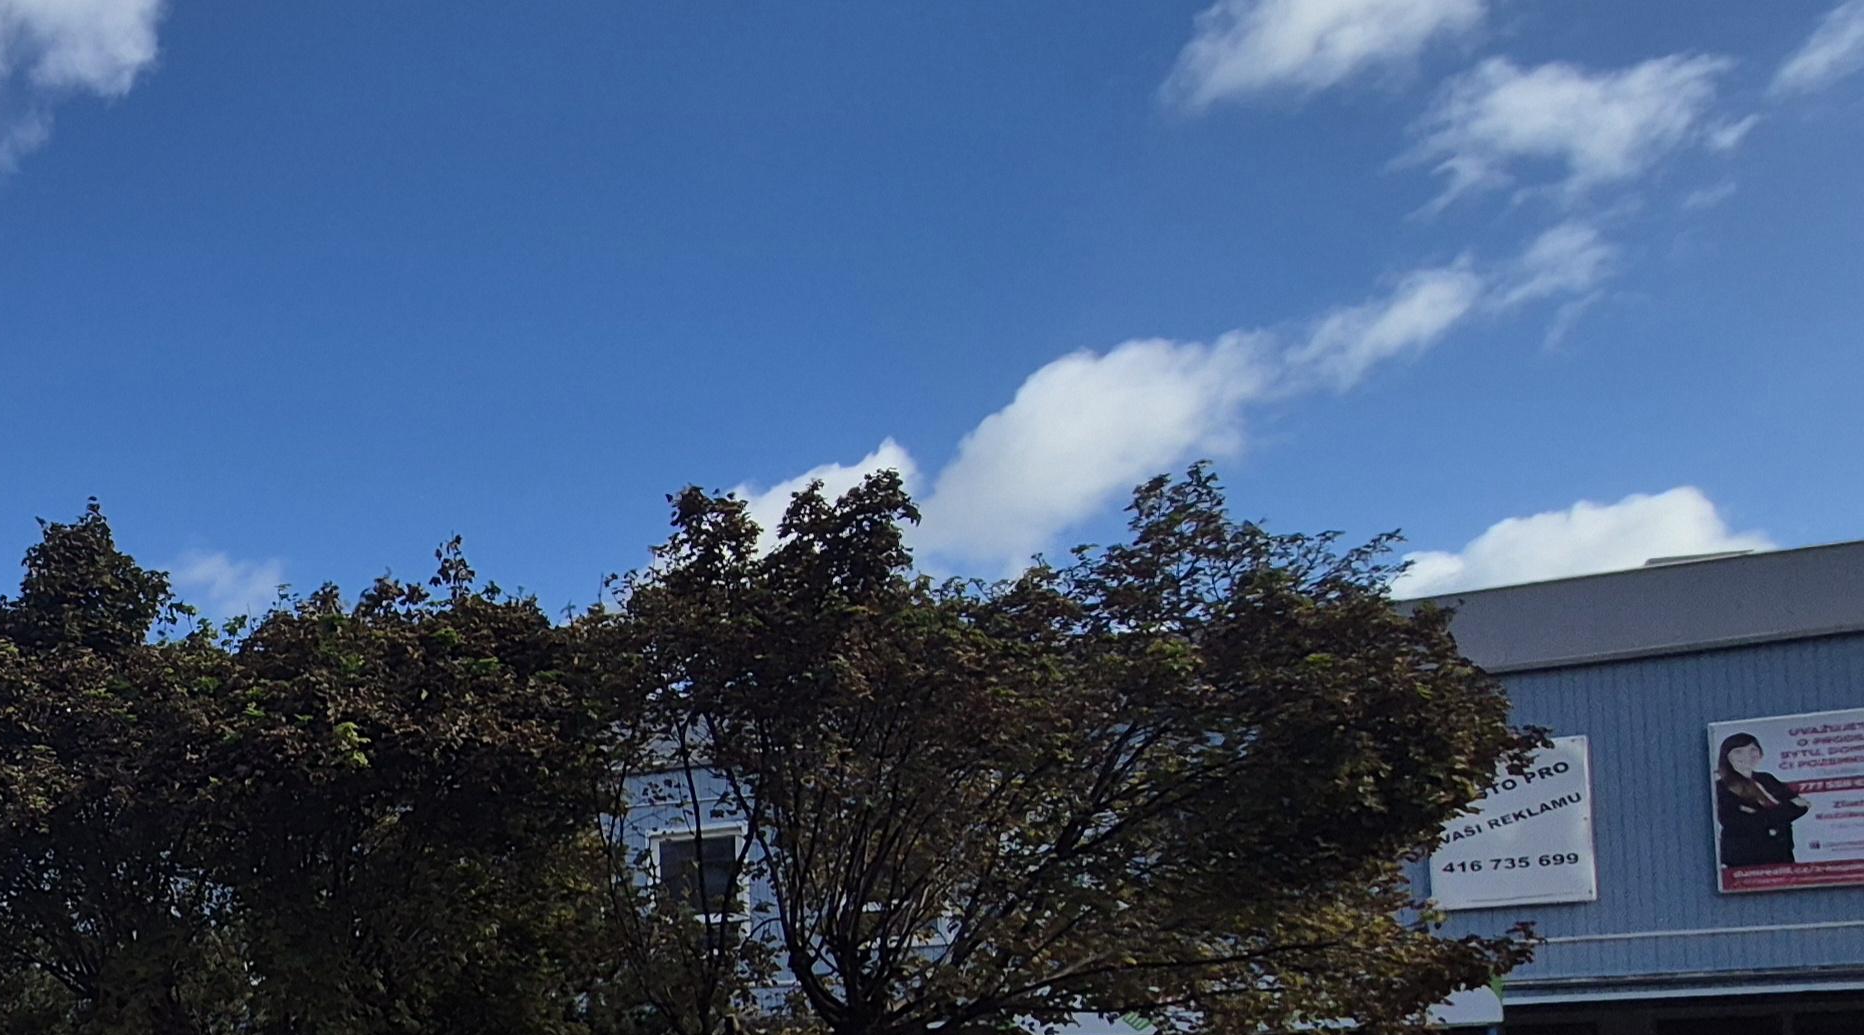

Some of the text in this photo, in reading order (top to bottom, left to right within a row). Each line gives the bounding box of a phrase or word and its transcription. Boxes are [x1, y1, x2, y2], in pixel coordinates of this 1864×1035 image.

[1524, 761, 1569, 784] PRO
[1439, 792, 1582, 844] VAŠI REKLAMU
[1442, 852, 1579, 873] 416 735 699
